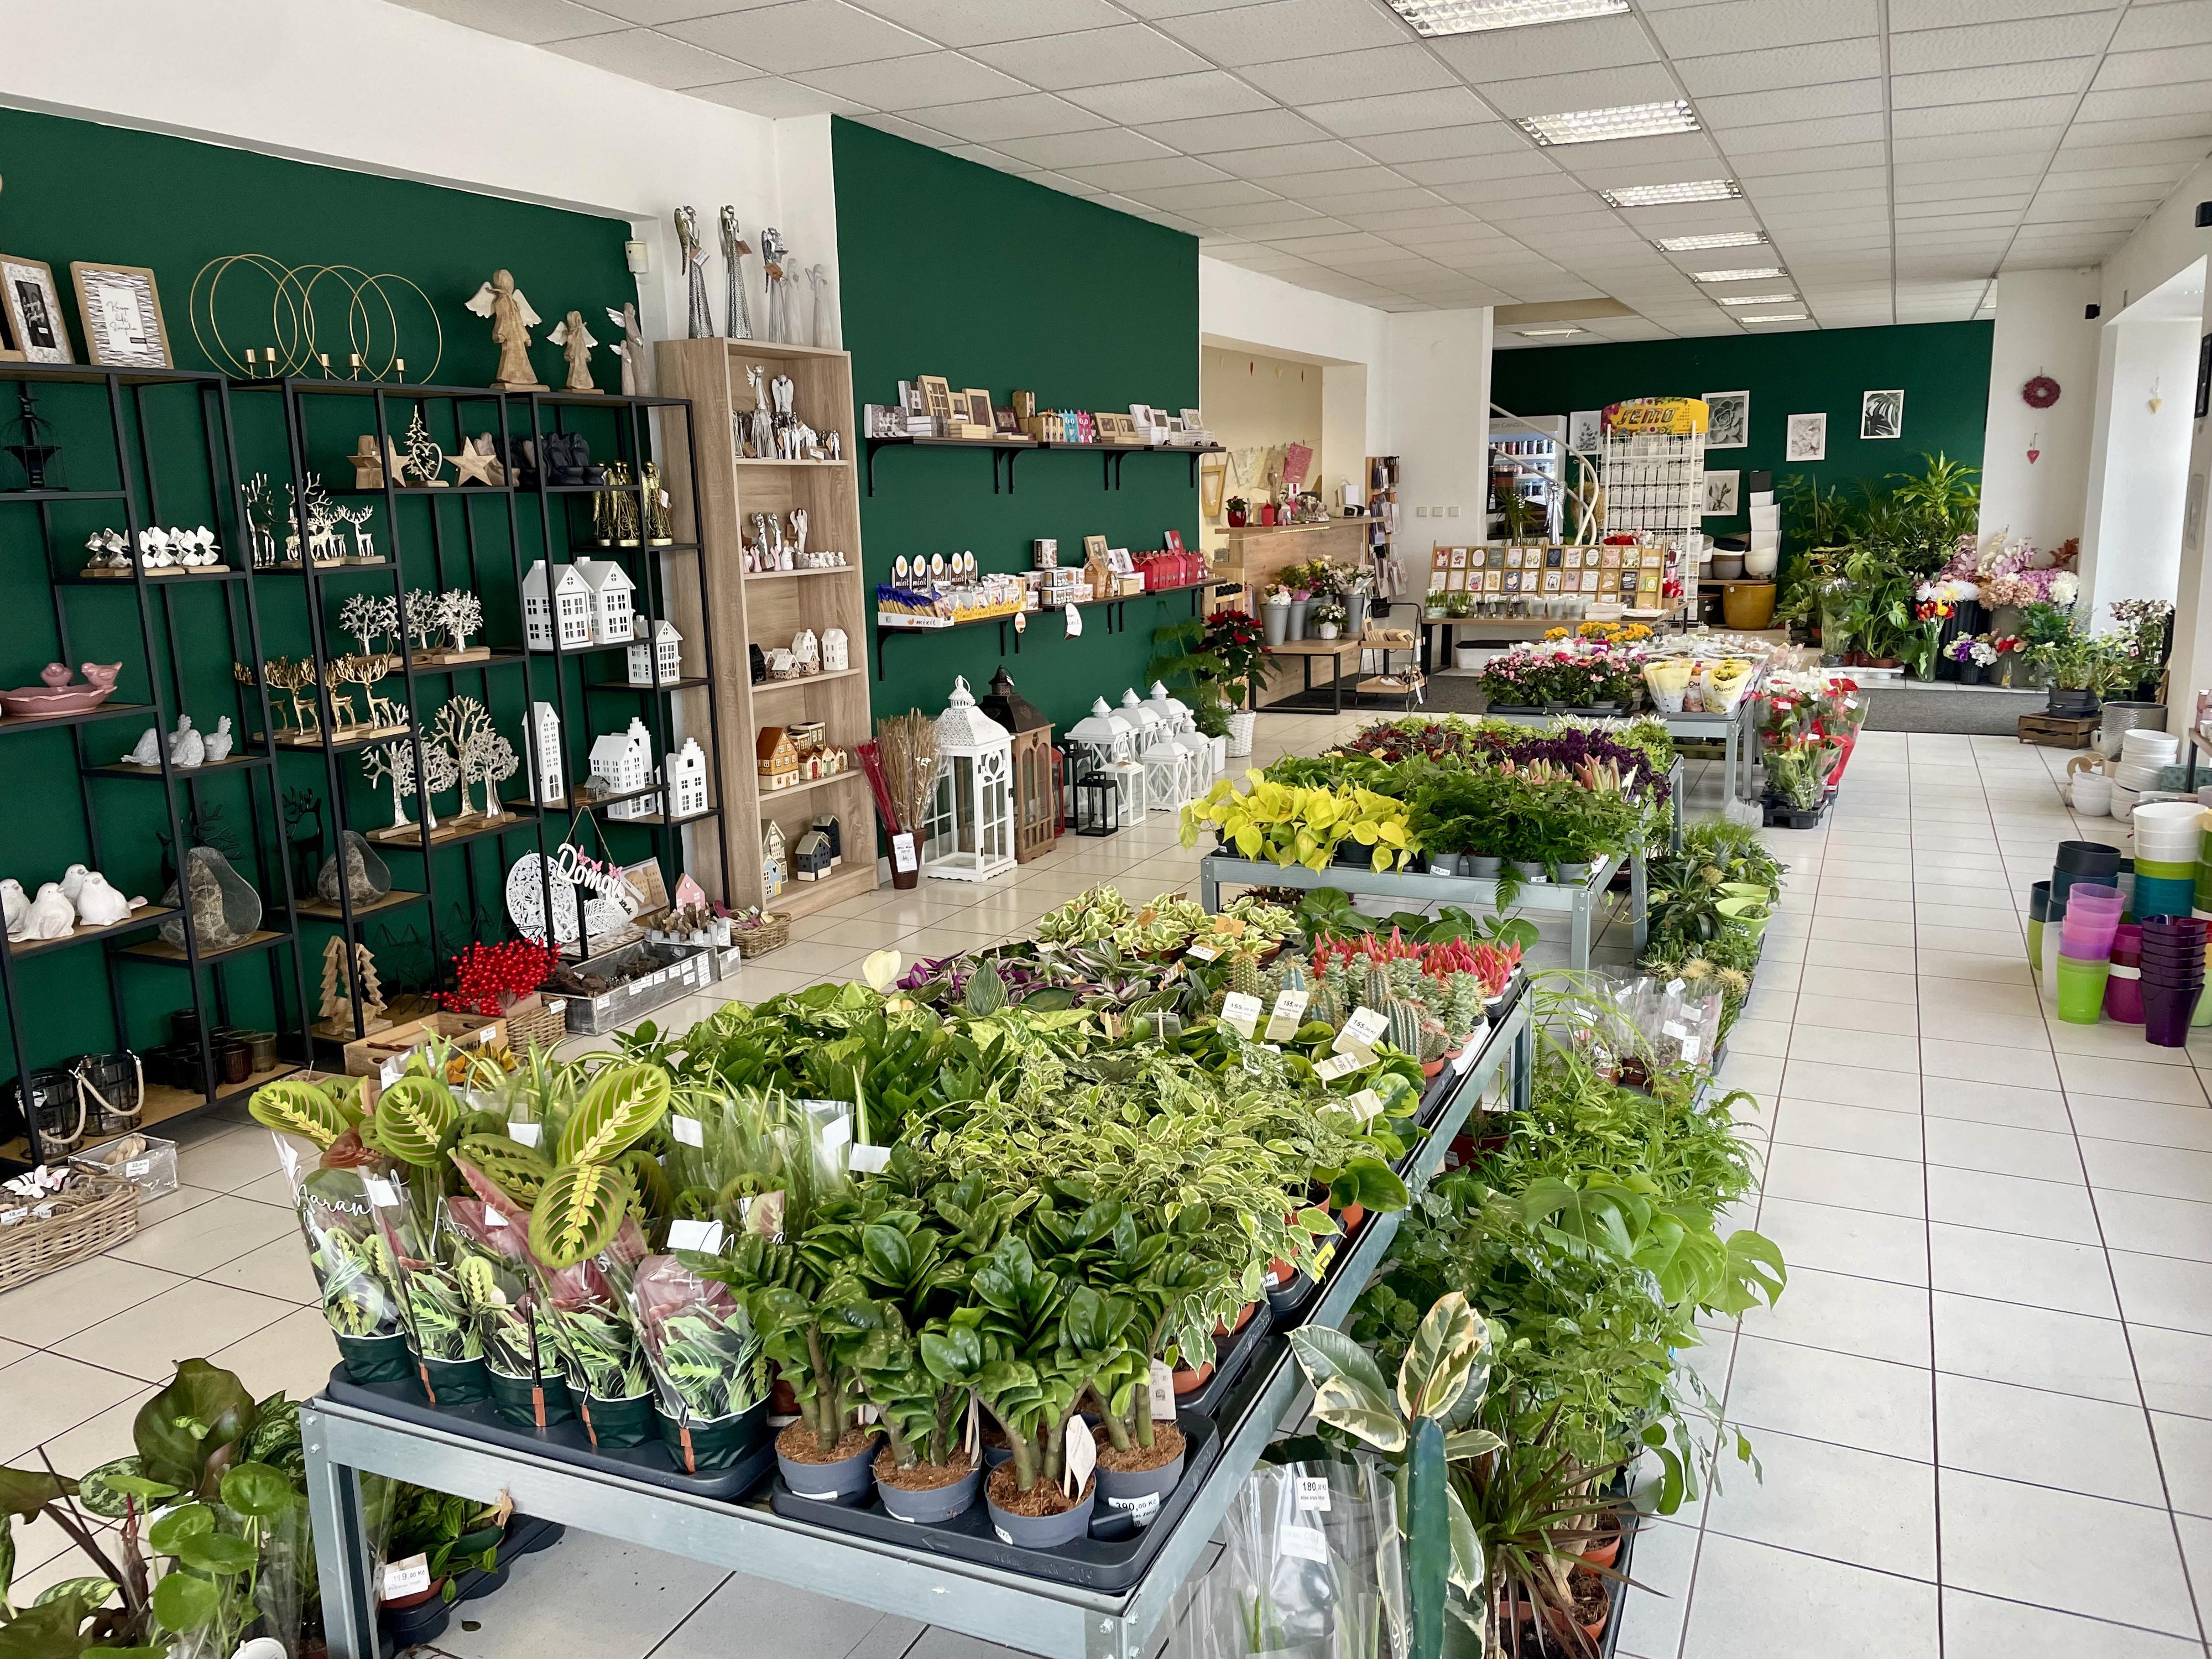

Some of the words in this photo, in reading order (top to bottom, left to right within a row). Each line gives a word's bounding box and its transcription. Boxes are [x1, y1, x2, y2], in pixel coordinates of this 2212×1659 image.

[896, 577, 909, 587] mixit
[912, 577, 927, 586] mixit
[951, 575, 964, 583] mixit
[1354, 1020, 1370, 1031] 155,00
[1302, 1481, 1322, 1493] 180,00
